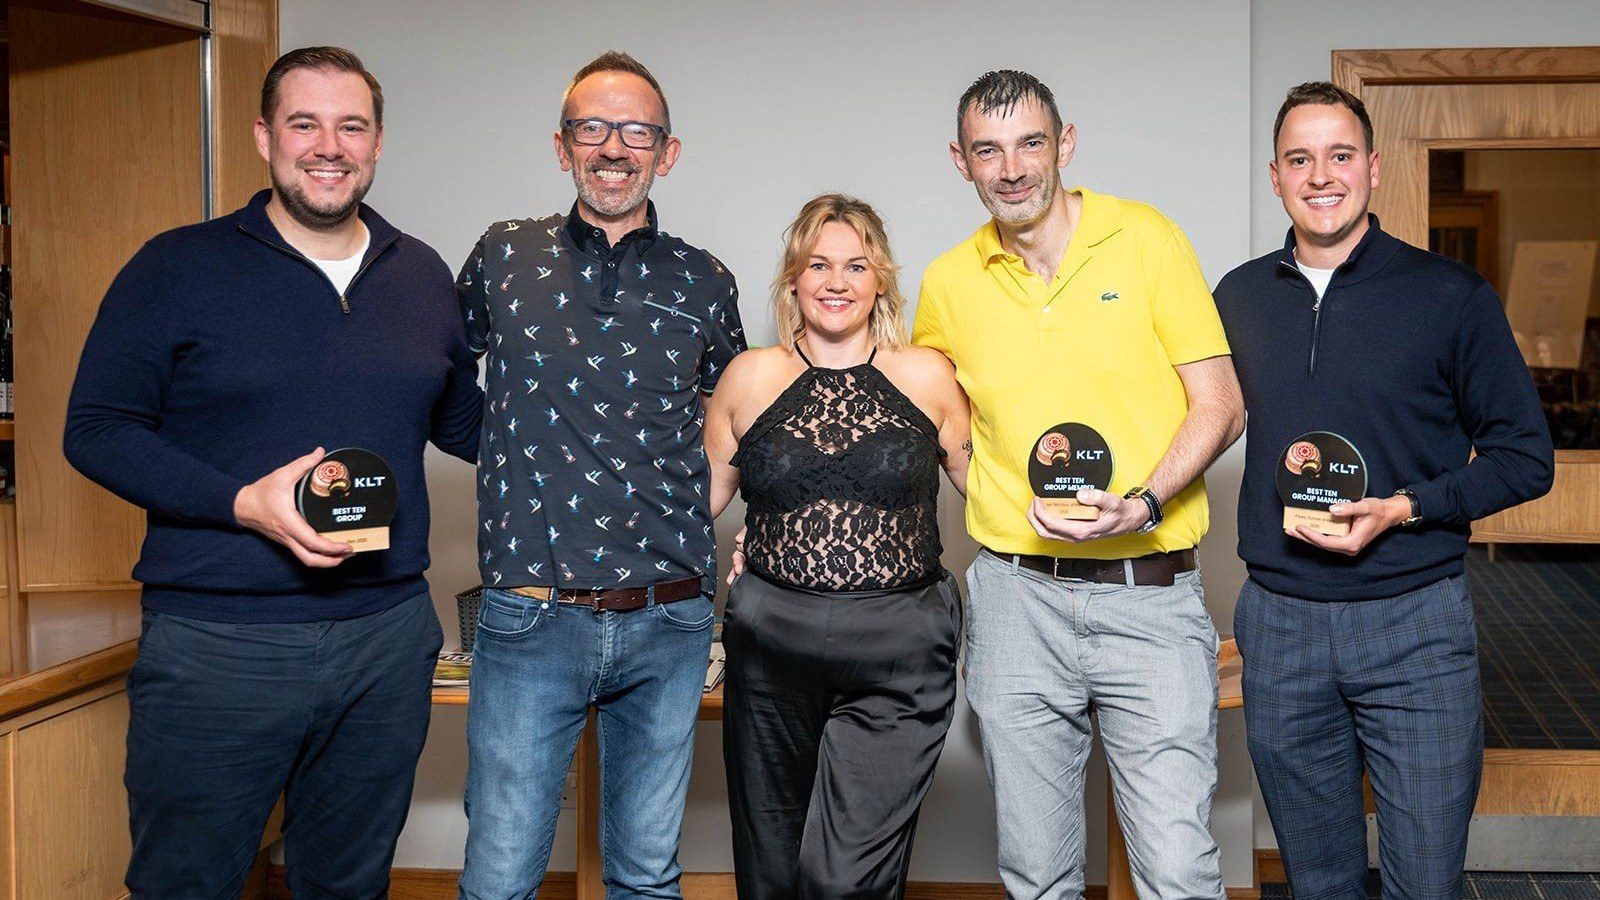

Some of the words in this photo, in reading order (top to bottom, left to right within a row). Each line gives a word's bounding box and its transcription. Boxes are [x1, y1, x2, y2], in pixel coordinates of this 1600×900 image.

[1076, 450, 1104, 460] KLT
[1329, 462, 1358, 475] KLT
[354, 476, 386, 488] KLT
[1292, 493, 1316, 502] GROUP
[1306, 487, 1323, 496] BEST
[1324, 489, 1338, 498] TEN
[352, 506, 366, 514] TEN
[336, 514, 363, 523] GROUP
